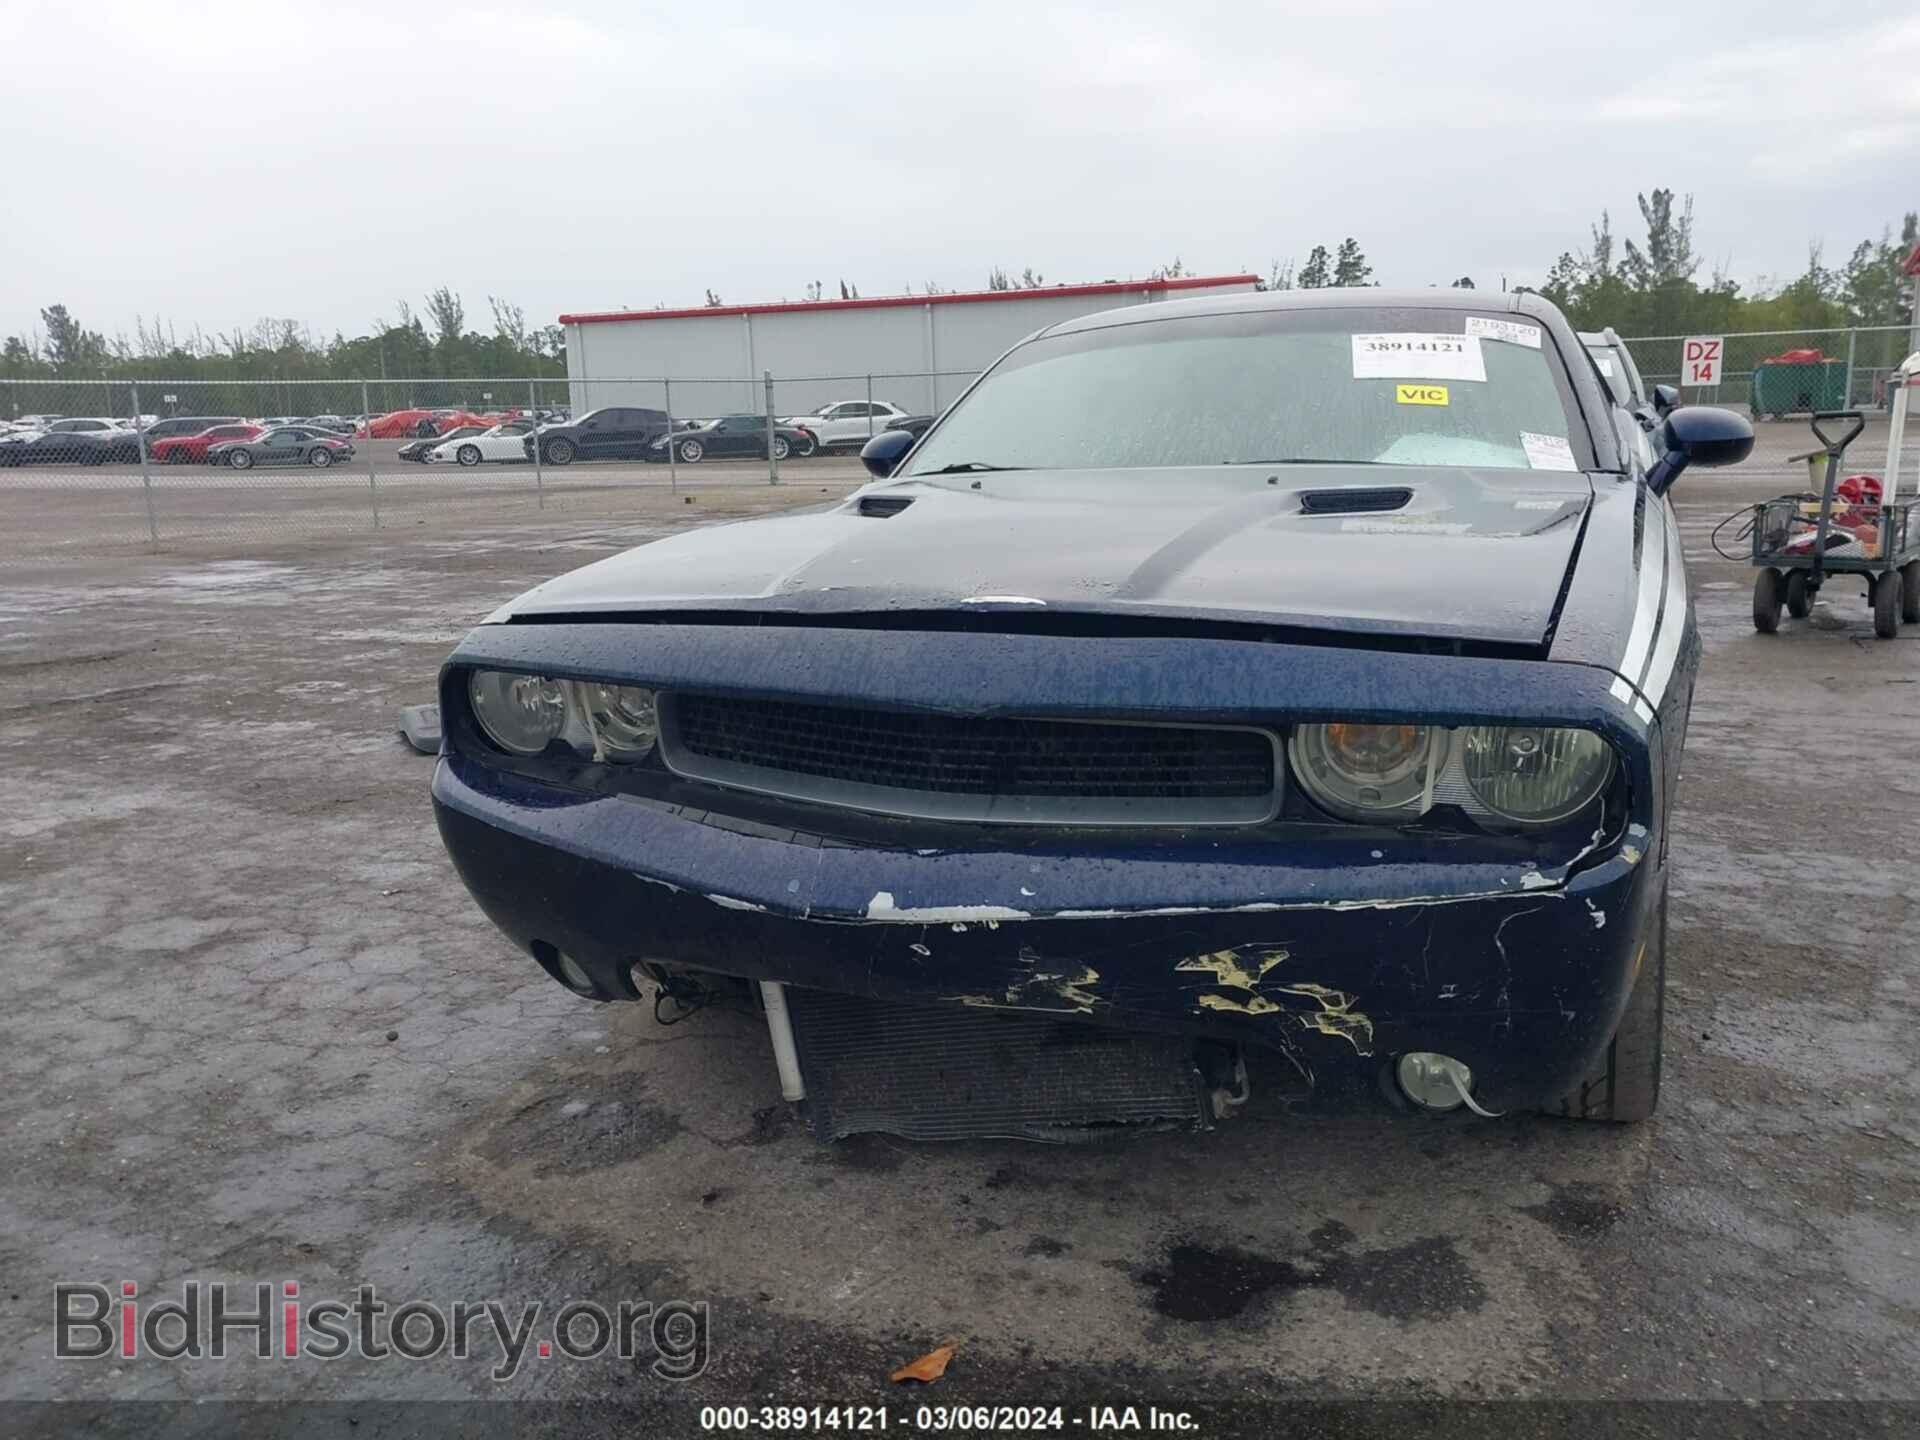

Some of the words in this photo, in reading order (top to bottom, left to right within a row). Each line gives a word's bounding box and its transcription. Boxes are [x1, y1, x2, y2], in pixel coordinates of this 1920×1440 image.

[1365, 342, 1463, 353] 38914121
[1687, 341, 1719, 361] DZ
[1692, 363, 1712, 382] 14
[1401, 389, 1443, 401] VIC
